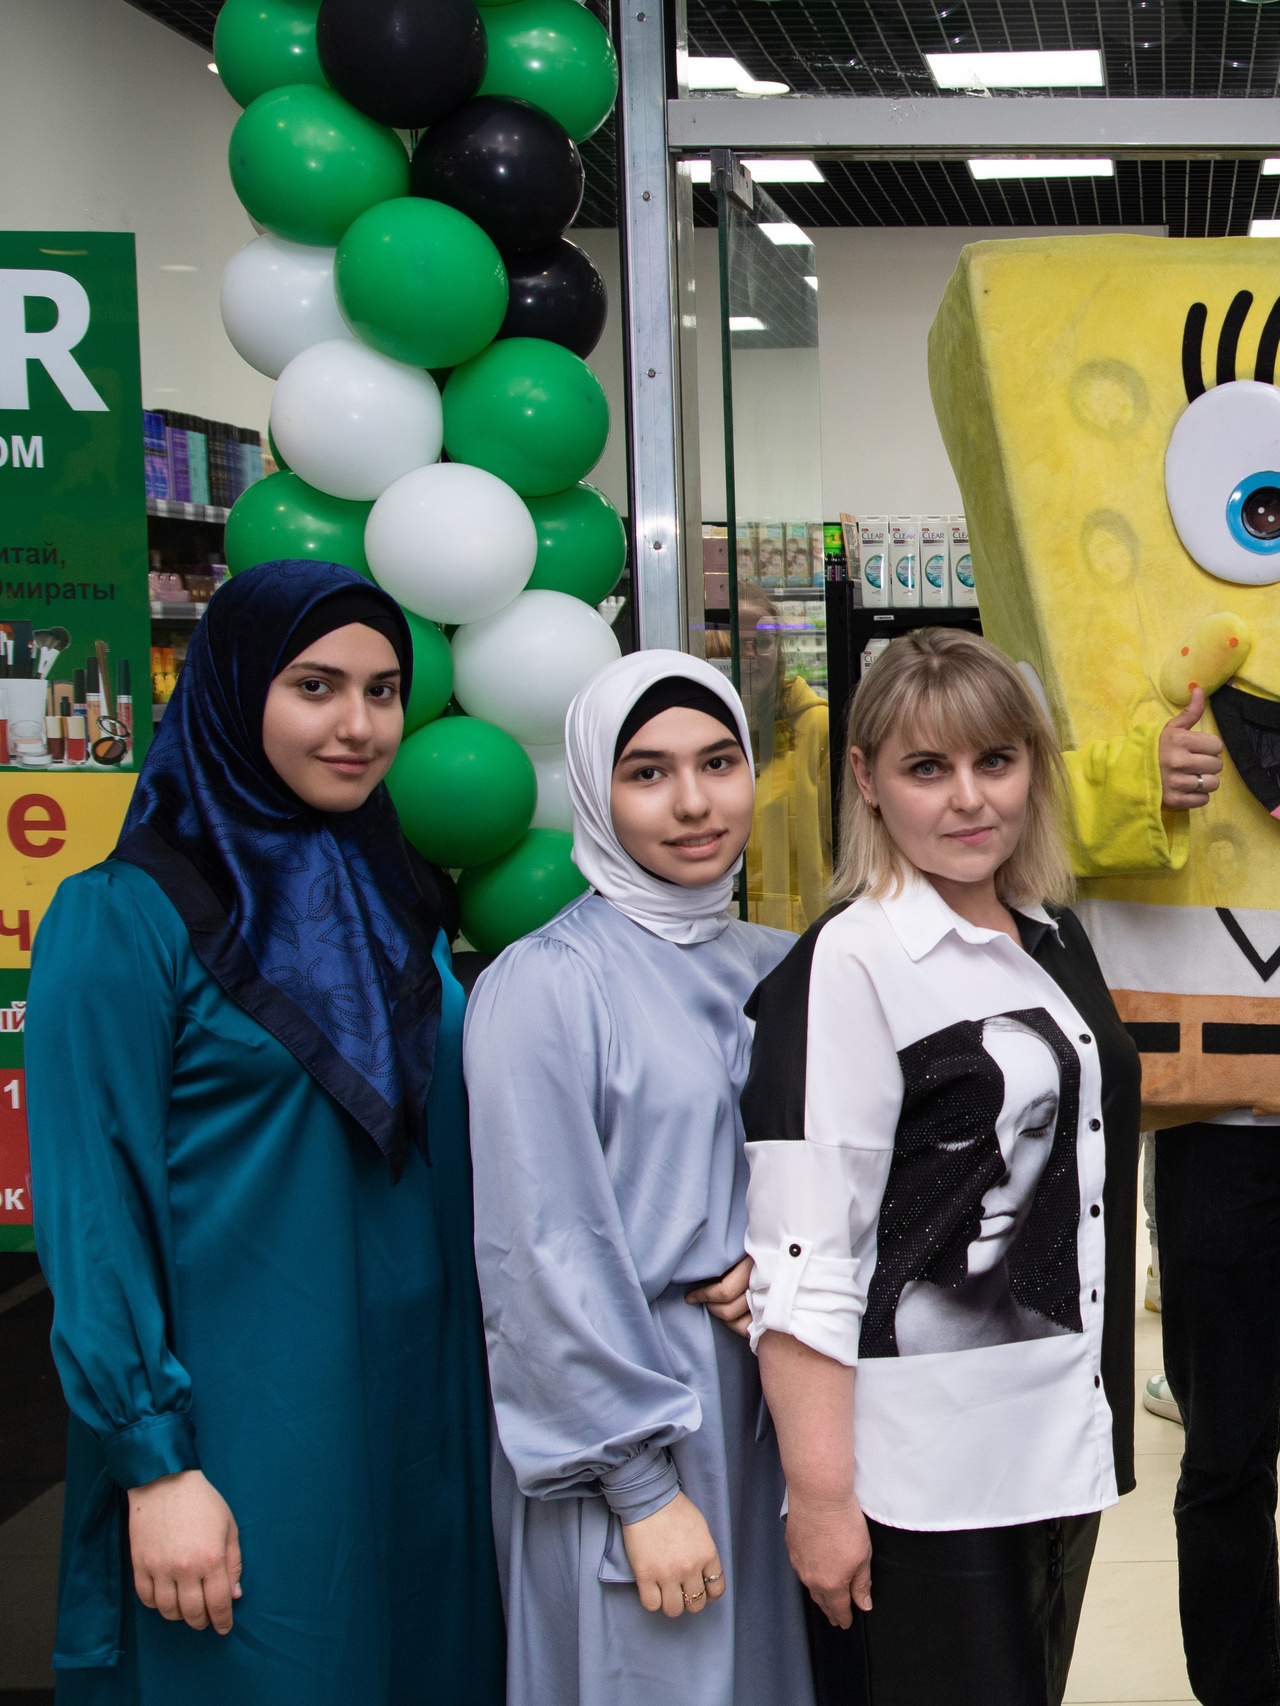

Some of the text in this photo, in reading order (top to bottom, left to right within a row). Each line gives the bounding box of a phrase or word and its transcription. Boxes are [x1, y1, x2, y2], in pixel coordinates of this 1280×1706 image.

[861, 531, 884, 540] CLEAR
[893, 531, 916, 540] CLEAR
[922, 531, 945, 539] CLEAR
[952, 531, 969, 539] CLEA
[0, 581, 115, 605] мираты
[7, 793, 67, 859] е
